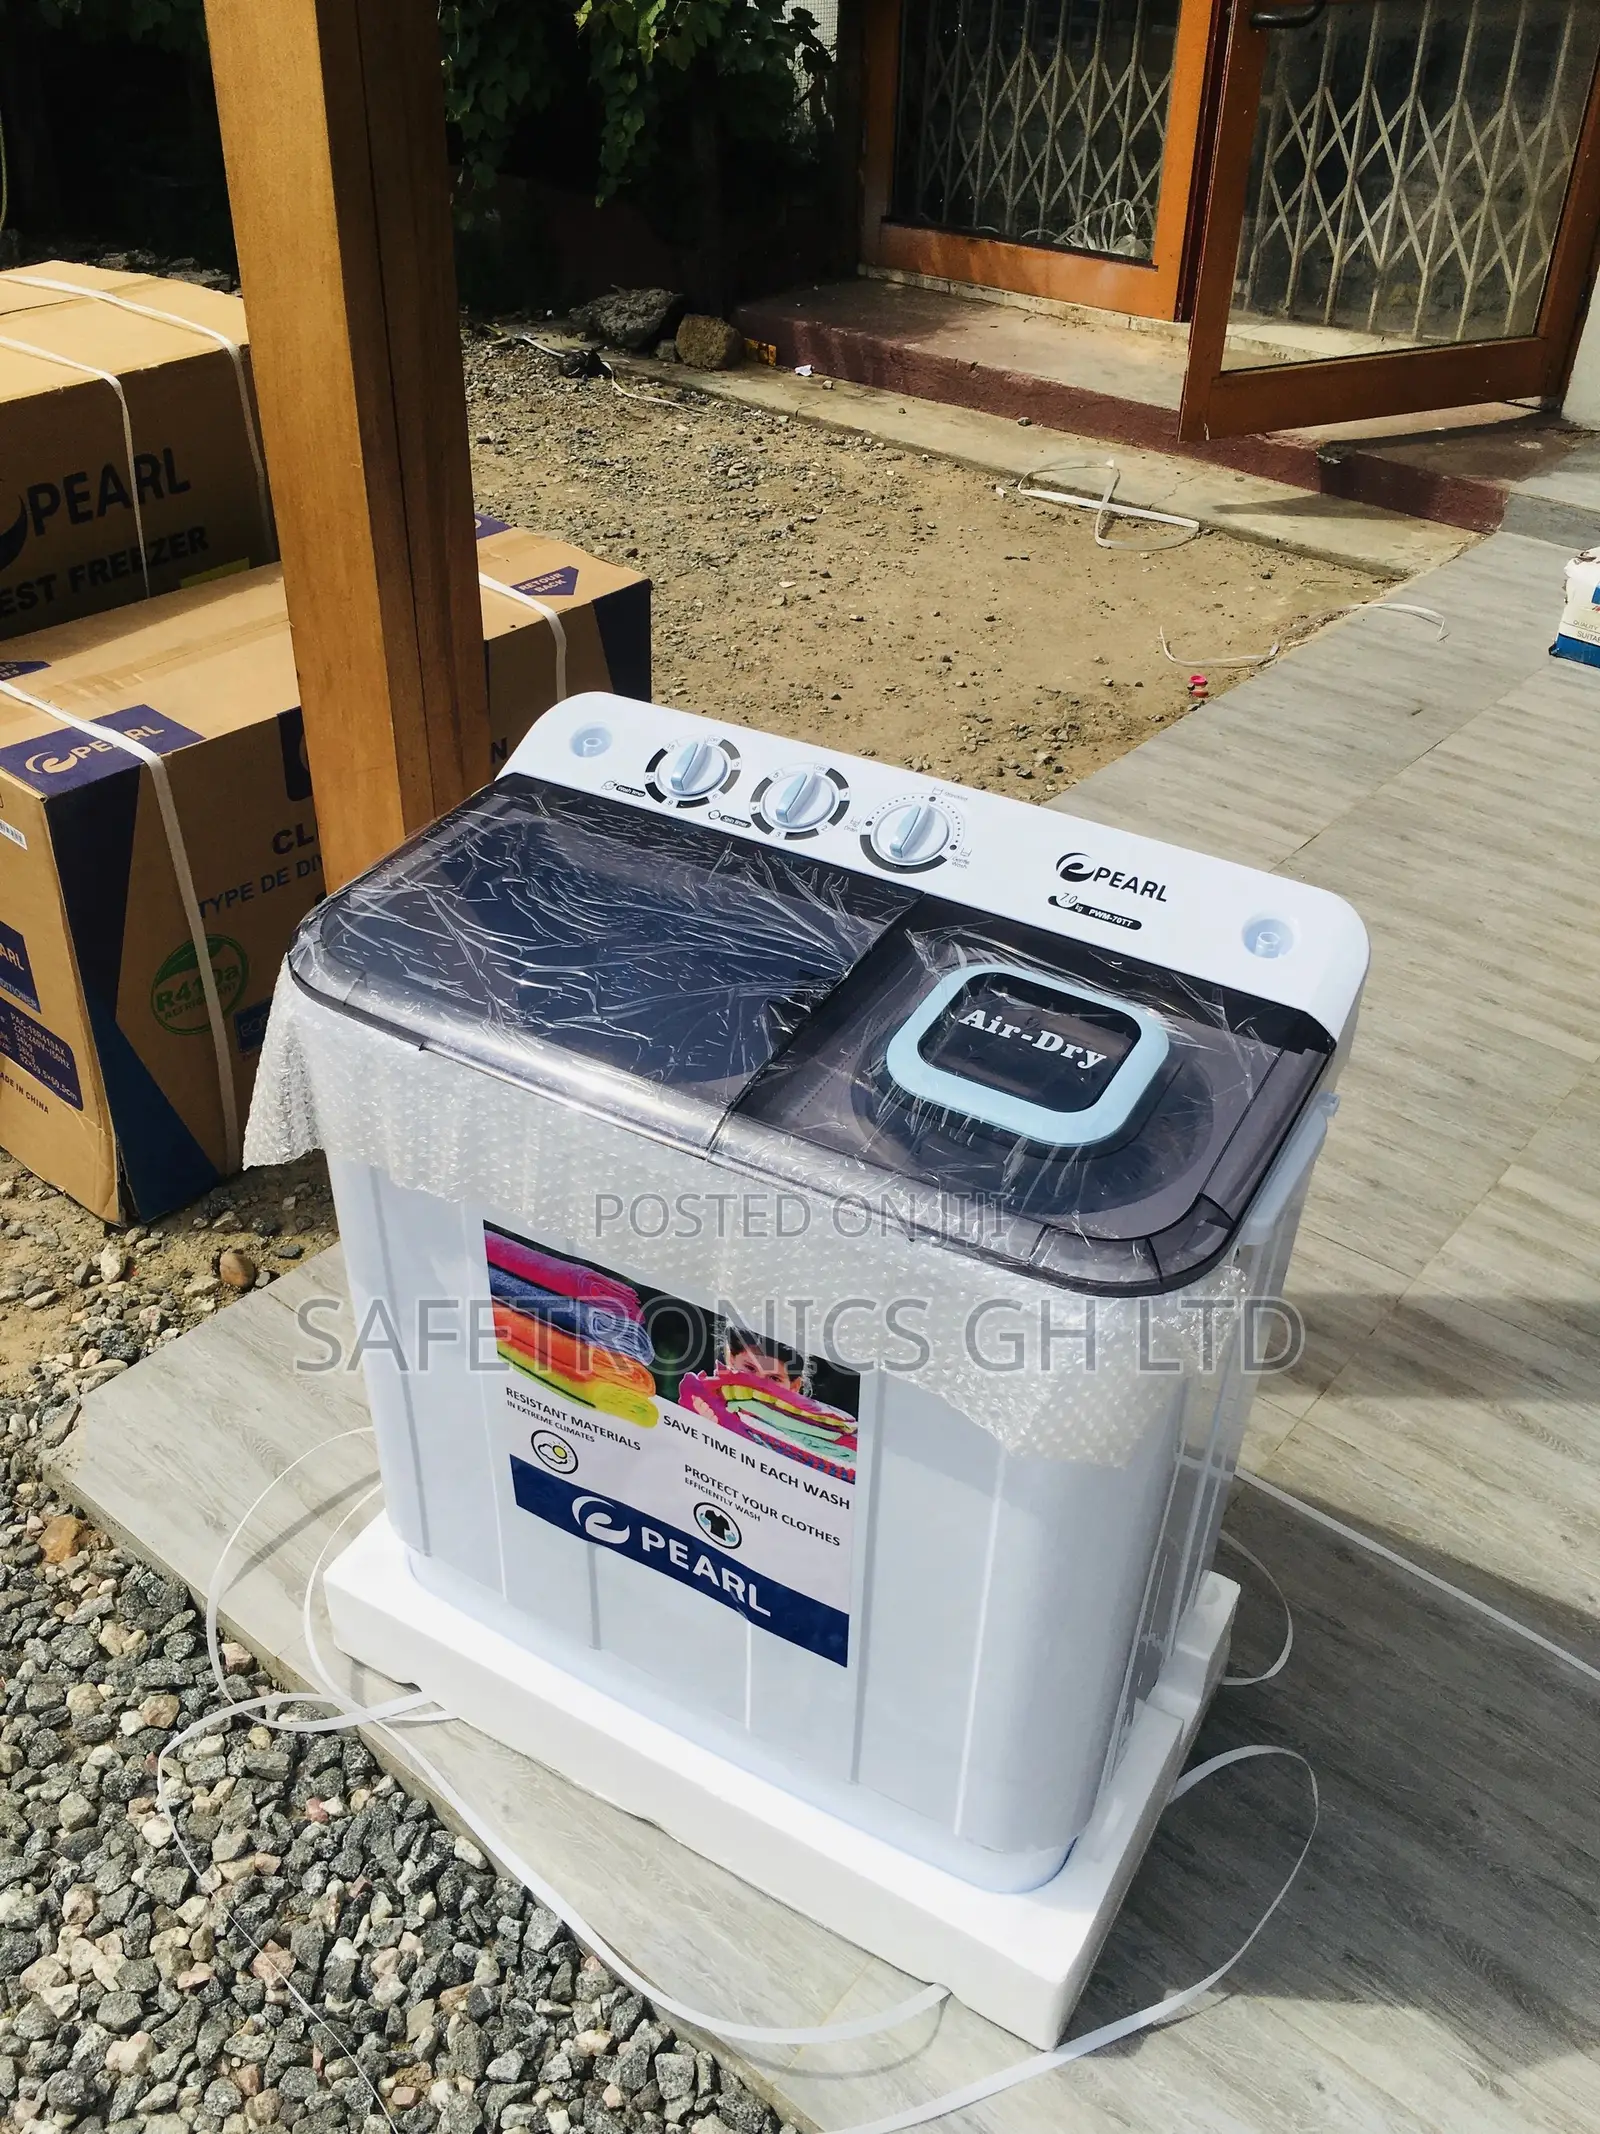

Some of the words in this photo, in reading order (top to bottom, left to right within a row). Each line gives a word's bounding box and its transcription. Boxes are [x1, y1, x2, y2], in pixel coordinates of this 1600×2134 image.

[27, 447, 191, 537] PEARL
[68, 525, 209, 593] FREEZER
[518, 572, 565, 591] RETOUR
[534, 579, 568, 593] BACK
[70, 725, 165, 760] PERL
[199, 882, 254, 920] TYPE
[261, 866, 291, 894] DE
[1092, 866, 1168, 903] PEARL
[1059, 892, 1079, 904] 7.0
[1075, 903, 1083, 912] kg
[1088, 908, 1134, 928] PWM-70TT
[958, 1008, 1109, 1071] Air-Dry
[16, 1085, 24, 1096] IN
[25, 1091, 50, 1115] CHINA
[506, 1386, 568, 1422] RESISTANT
[570, 1415, 641, 1451] MATERIALS
[507, 1399, 516, 1408] IN
[517, 1404, 554, 1426] EXTREME
[554, 1421, 595, 1443] CLIMATES
[663, 1415, 699, 1440] SAVE
[701, 1433, 737, 1459] TIME
[740, 1452, 756, 1469] IN
[760, 1462, 799, 1489] EACH
[802, 1481, 851, 1510] WASH
[684, 1476, 734, 1507] EFFICIENTLY
[735, 1503, 761, 1522] WASH
[684, 1463, 739, 1499] PROTECT
[741, 1493, 779, 1520] YOUR
[781, 1514, 841, 1547] CLOTHES
[641, 1525, 772, 1618] PEARL
